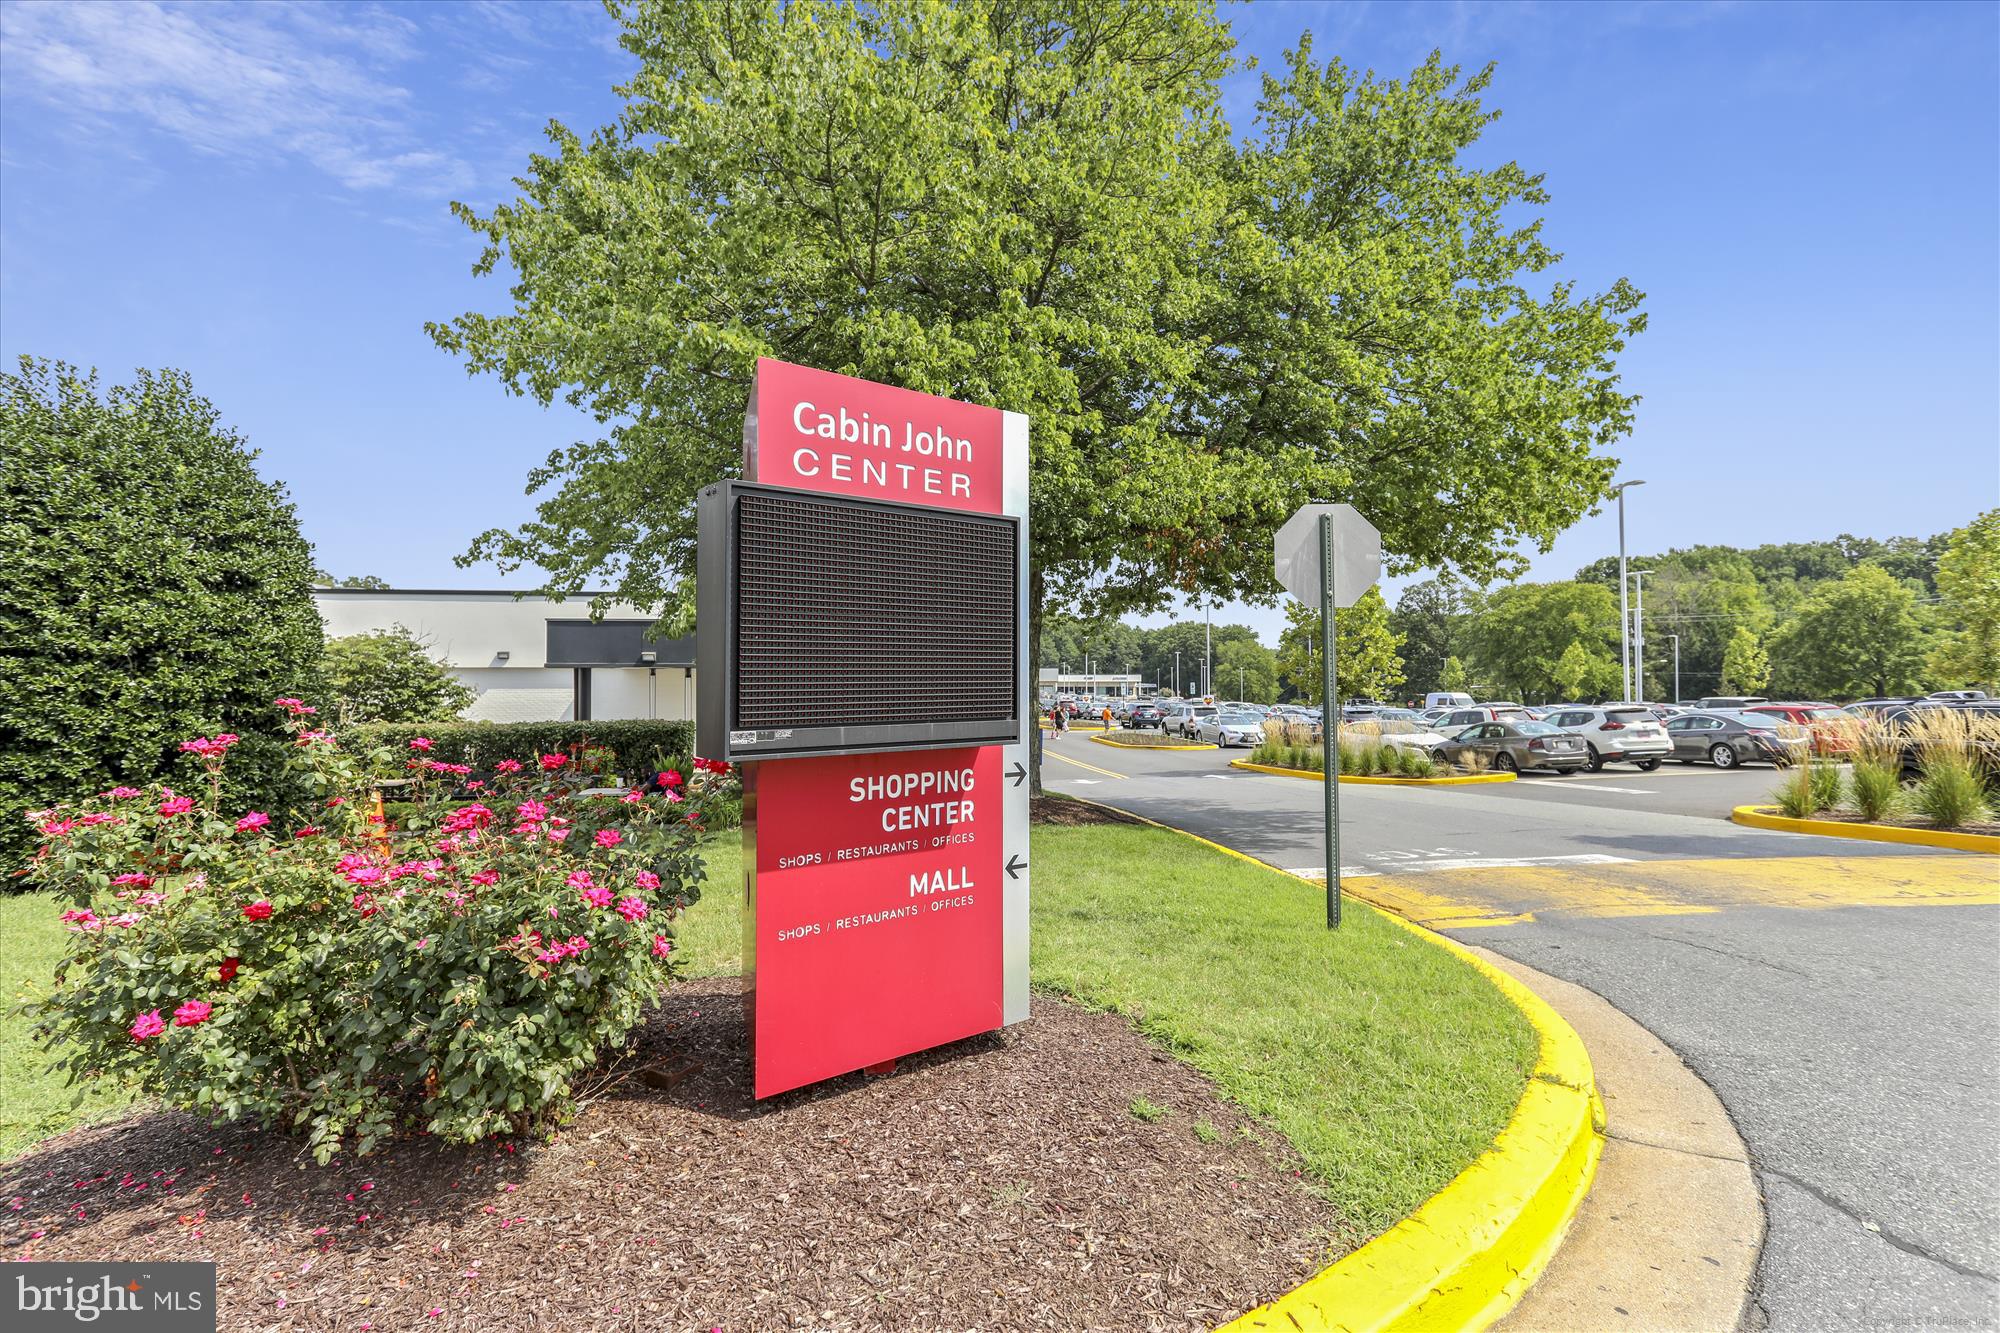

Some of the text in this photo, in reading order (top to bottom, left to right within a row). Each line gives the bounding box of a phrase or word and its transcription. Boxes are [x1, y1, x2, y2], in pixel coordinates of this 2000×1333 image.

[793, 401, 972, 463] Cabin John
[792, 448, 971, 499] CENTER
[849, 768, 975, 802] SHOPPING
[882, 800, 975, 832] CENTER
[778, 852, 821, 869] SHOPS
[837, 841, 919, 861] RESTAURANTS
[931, 832, 975, 847] OFFICES
[909, 867, 975, 898] MALL
[778, 923, 821, 942] SHOPS
[836, 904, 919, 930] RESTAURANTS
[930, 895, 974, 912] OFFICES
